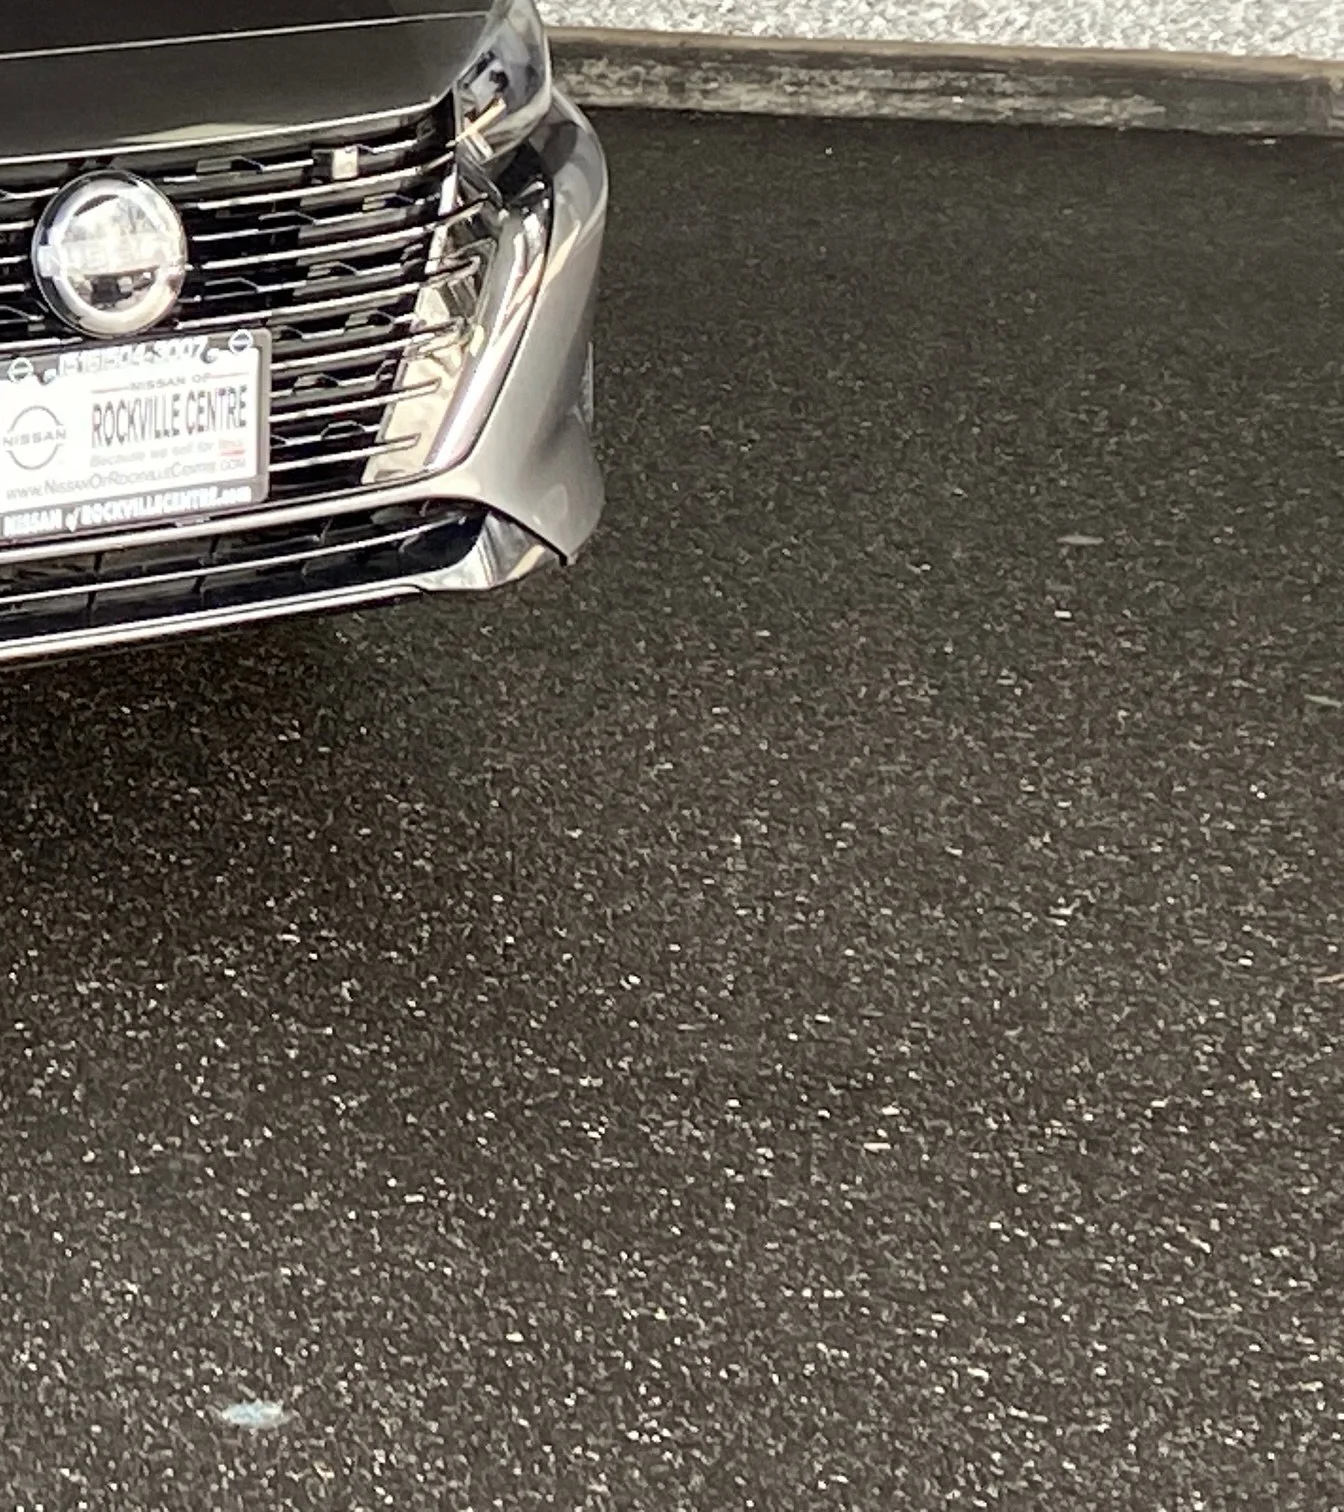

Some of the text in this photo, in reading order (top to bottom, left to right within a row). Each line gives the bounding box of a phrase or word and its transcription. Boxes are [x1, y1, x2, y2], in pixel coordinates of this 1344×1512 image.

[91, 384, 249, 449] ROCKVILLE CENTRE
[2, 428, 67, 448] NISSAN
